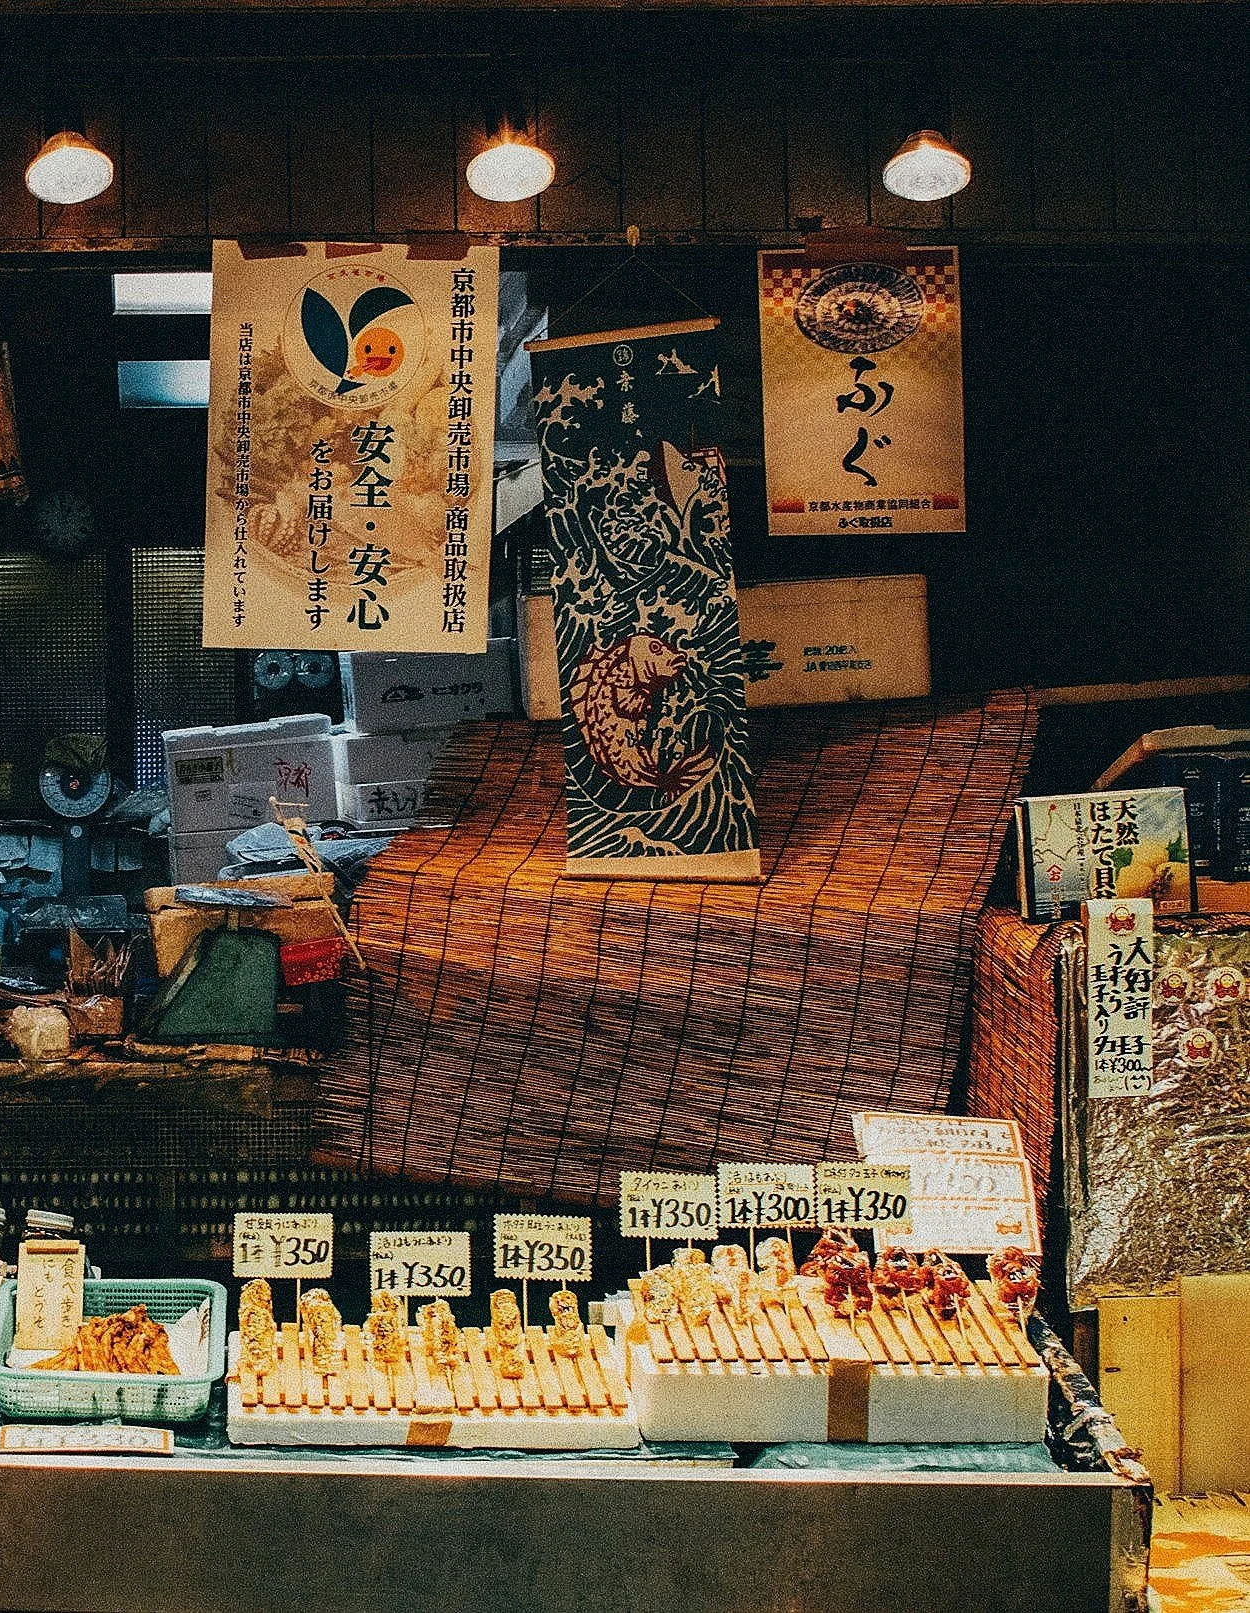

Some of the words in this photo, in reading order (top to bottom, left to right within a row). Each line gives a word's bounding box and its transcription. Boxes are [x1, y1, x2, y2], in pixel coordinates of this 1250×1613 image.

[447, 268, 475, 497] 京都市中央卸売市場
[836, 355, 895, 488] ふぐ
[233, 322, 253, 627] 当店は京都市中央卸売市場から仕入れています
[305, 440, 333, 630] をお届けします
[346, 422, 395, 631] 安全・安心
[441, 507, 469, 633] 商品取扱店
[1114, 798, 1140, 845] 天然
[1124, 937, 1152, 1021] 大好評
